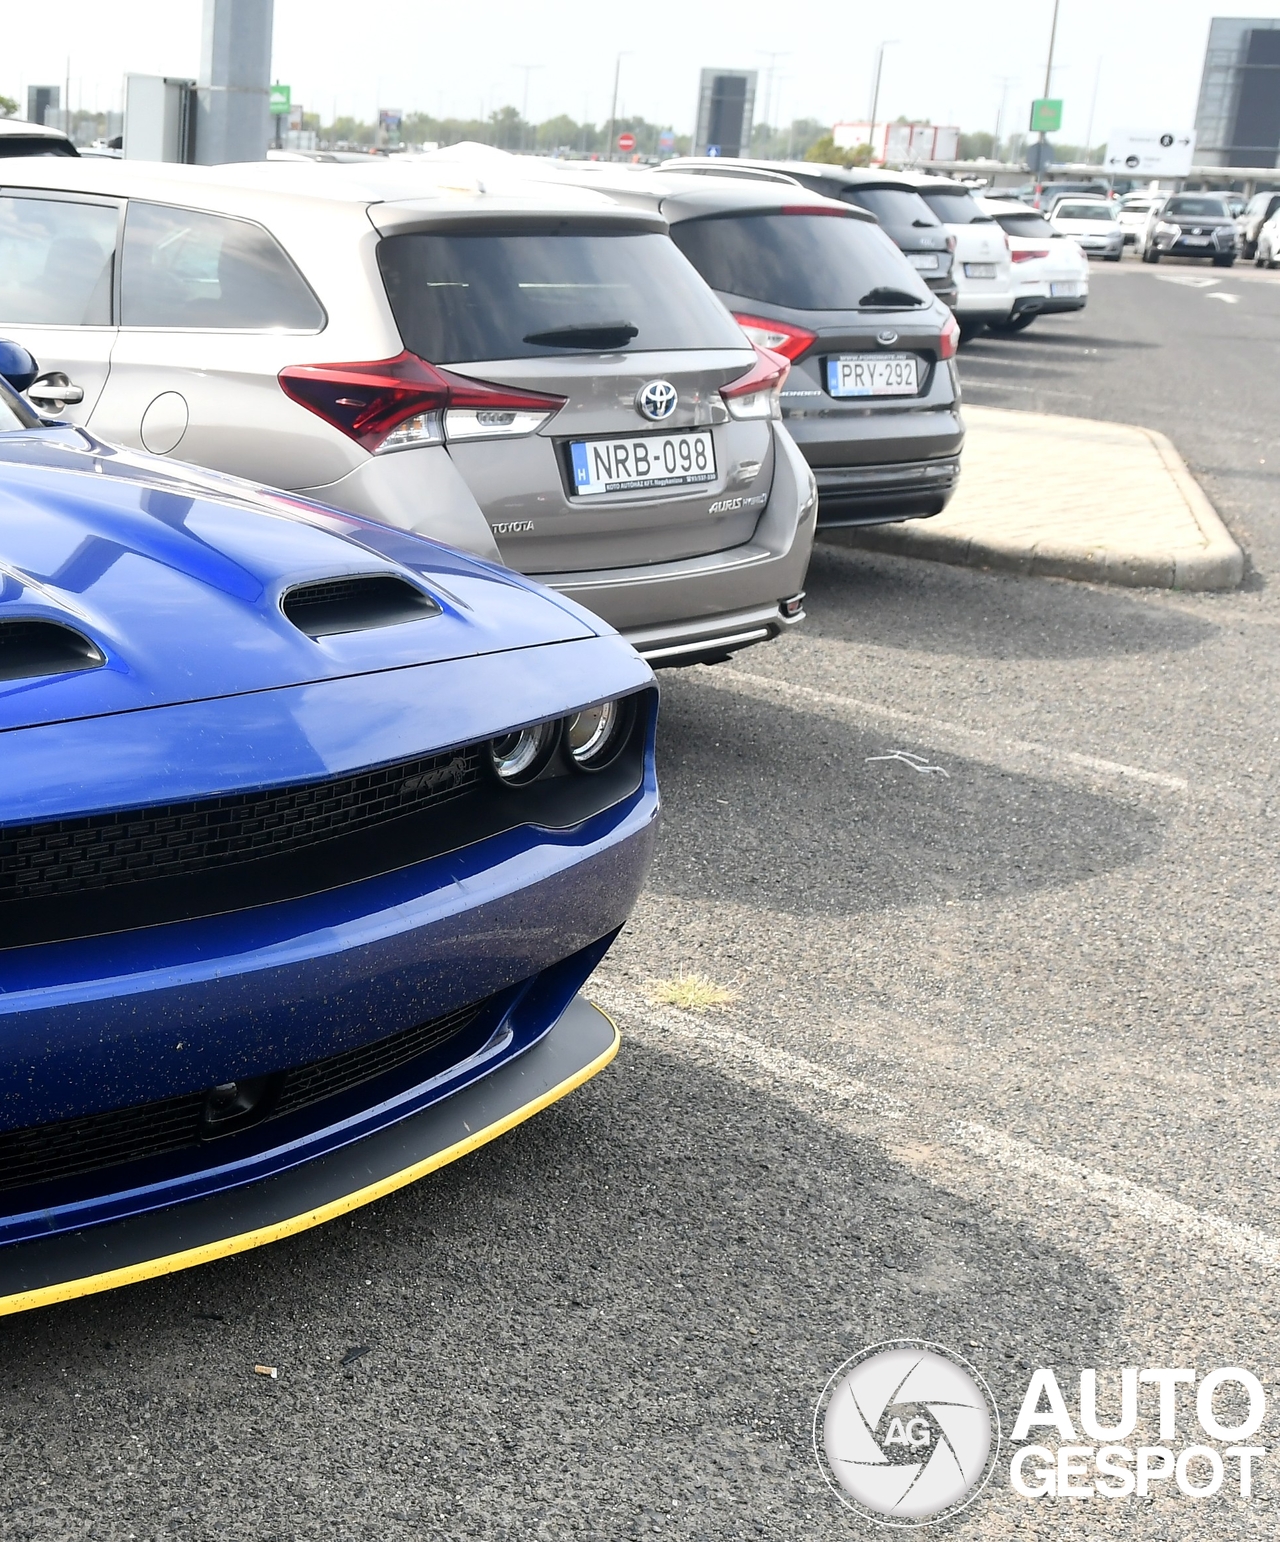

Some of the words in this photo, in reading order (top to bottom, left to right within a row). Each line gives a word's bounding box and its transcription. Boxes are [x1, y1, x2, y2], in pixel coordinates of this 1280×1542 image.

[842, 363, 913, 387] PRY-292
[593, 438, 707, 480] NRB-098
[578, 468, 586, 481] H
[708, 497, 743, 514] AURIS
[491, 520, 535, 534] TOYOTA
